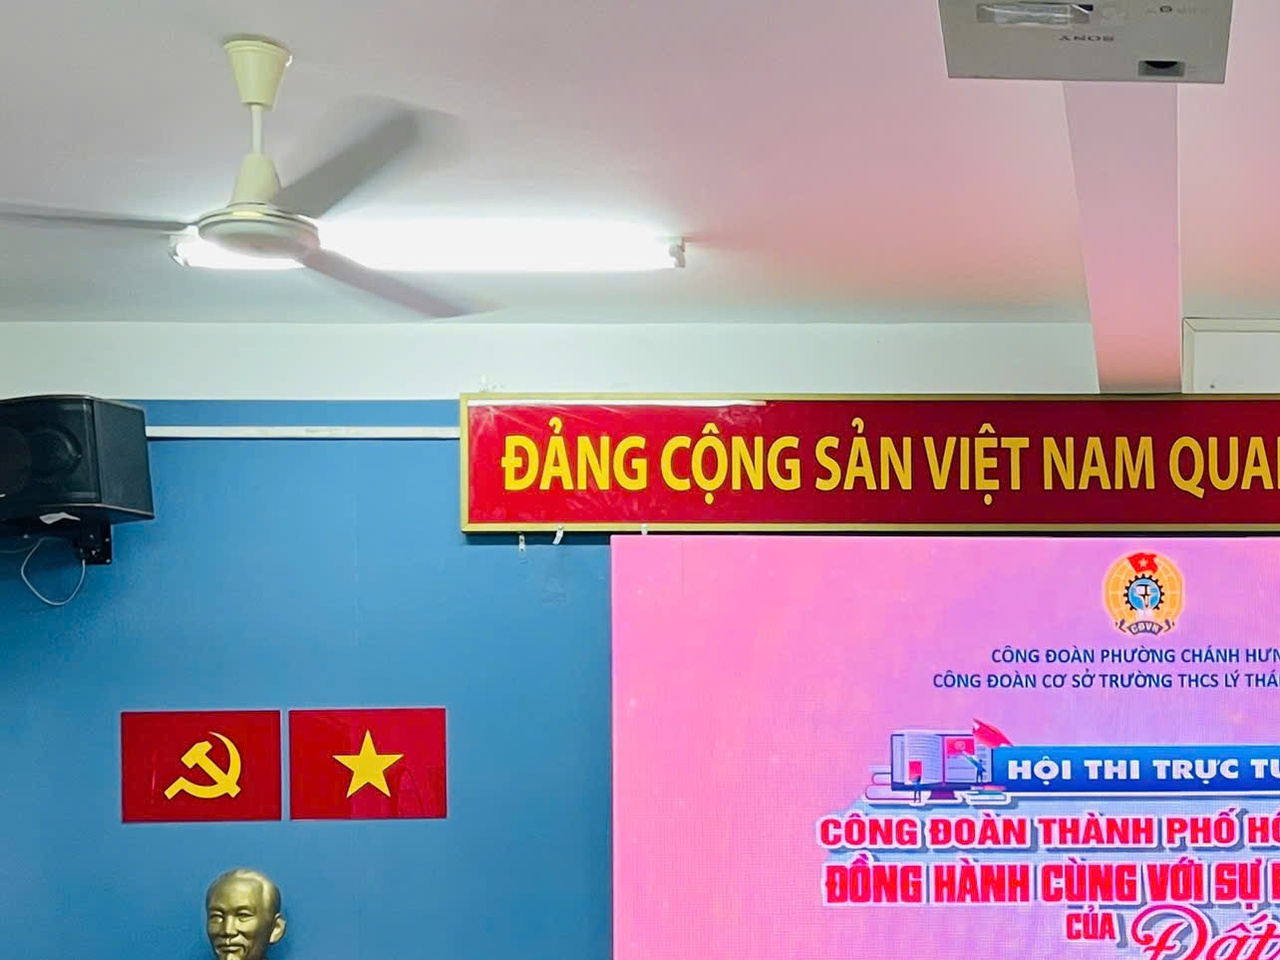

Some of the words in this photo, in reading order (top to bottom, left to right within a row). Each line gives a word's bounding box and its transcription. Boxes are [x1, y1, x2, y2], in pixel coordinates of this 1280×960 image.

[502, 416, 648, 491] ĐẢNG
[660, 422, 801, 505] CỘNG
[815, 416, 912, 491] SẢN
[925, 423, 1029, 506] VIỆT
[1043, 436, 1155, 491] NAM
[991, 645, 1040, 663] CÔNG
[1045, 645, 1095, 663] ĐOÀN
[1100, 645, 1176, 663] PHƯỜNG
[1181, 645, 1240, 663] CHÁNH
[933, 669, 981, 688] CÔNG
[986, 670, 1037, 688] ĐOÀN
[1042, 673, 1067, 688] CƠ
[1072, 668, 1096, 688] SỞ
[1098, 670, 1173, 688] TRƯỜNG
[1177, 673, 1219, 688] THCS
[1224, 669, 1240, 688] LÝ
[1007, 755, 1071, 785] HỘI
[1083, 759, 1140, 780] THI
[1152, 759, 1239, 784] TRỰC
[820, 812, 918, 846] CÔNG
[929, 812, 1027, 845] ĐOÀN
[1038, 811, 1154, 845] THÀNH
[1166, 807, 1237, 844] PHỐ
[825, 853, 922, 903] ĐỒNG
[933, 857, 1030, 902] HÀNH
[1040, 856, 1137, 902] CÙNG
[1146, 856, 1204, 901] VỚI
[1214, 857, 1263, 909] SỰ
[1066, 905, 1115, 940] CỦA
